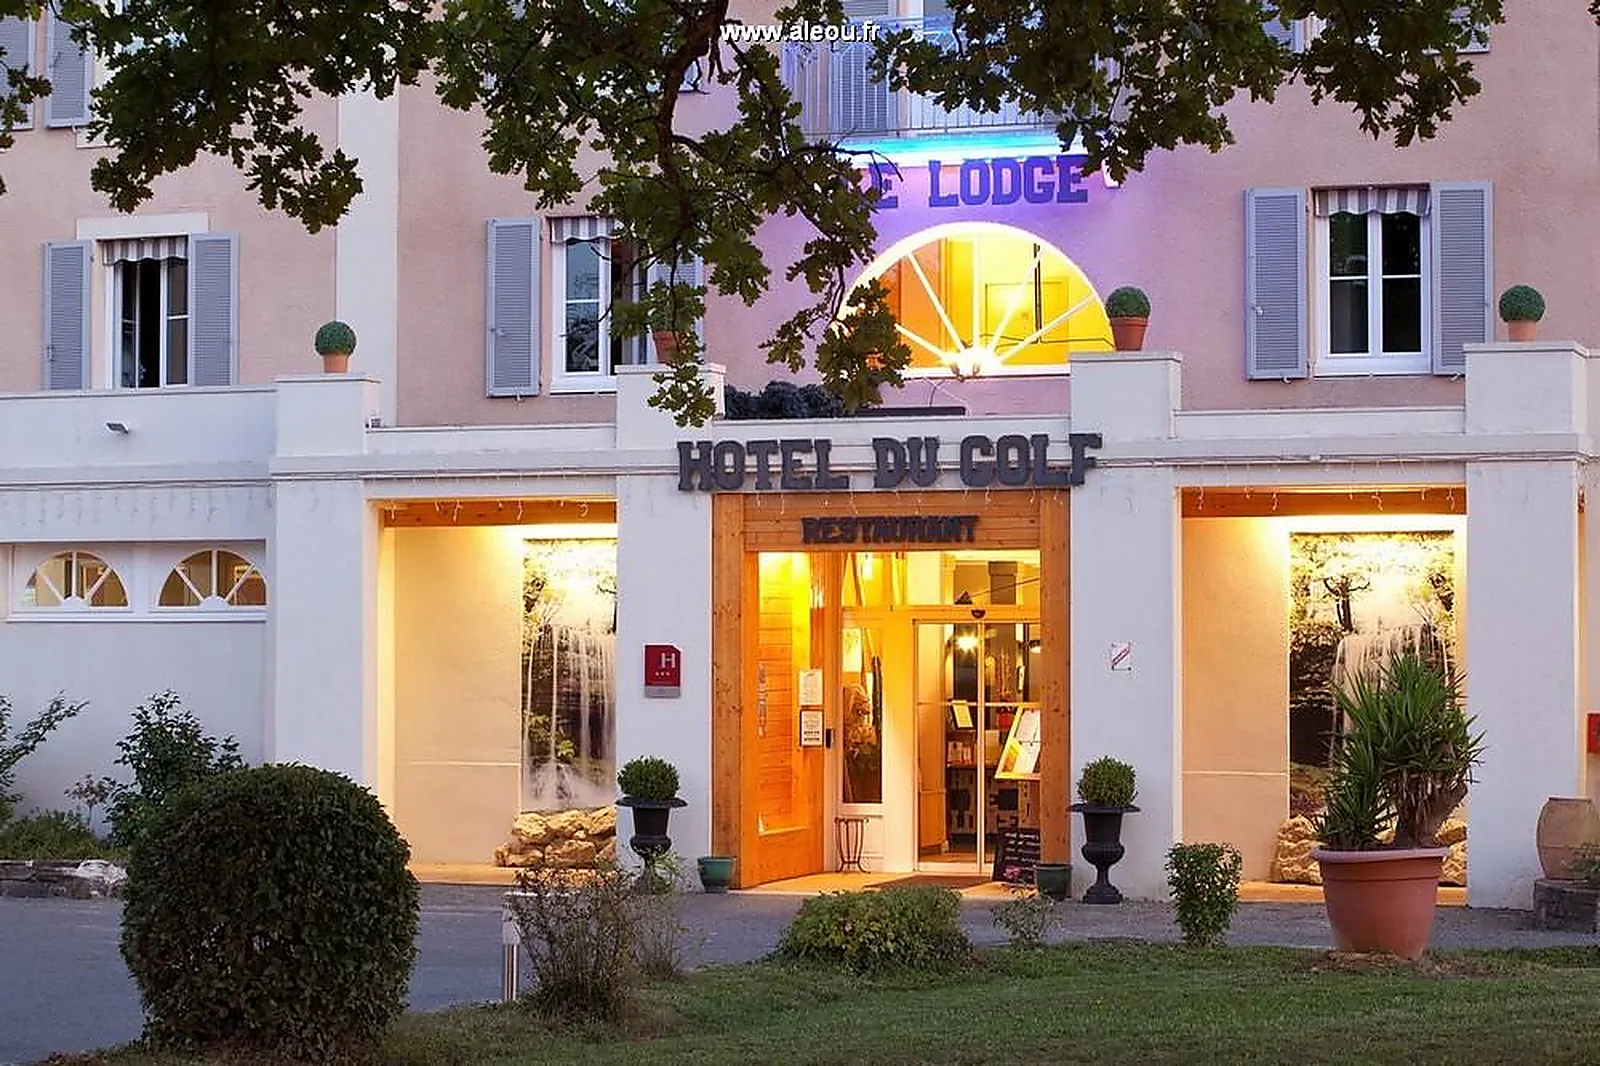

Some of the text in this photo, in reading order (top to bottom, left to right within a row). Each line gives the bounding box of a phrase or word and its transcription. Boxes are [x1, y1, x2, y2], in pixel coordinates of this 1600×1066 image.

[928, 155, 1088, 207] LODGE
[676, 433, 1103, 492] HOTEL DU GOLF
[801, 515, 979, 545] RESTAURANT
[661, 652, 676, 669] H
